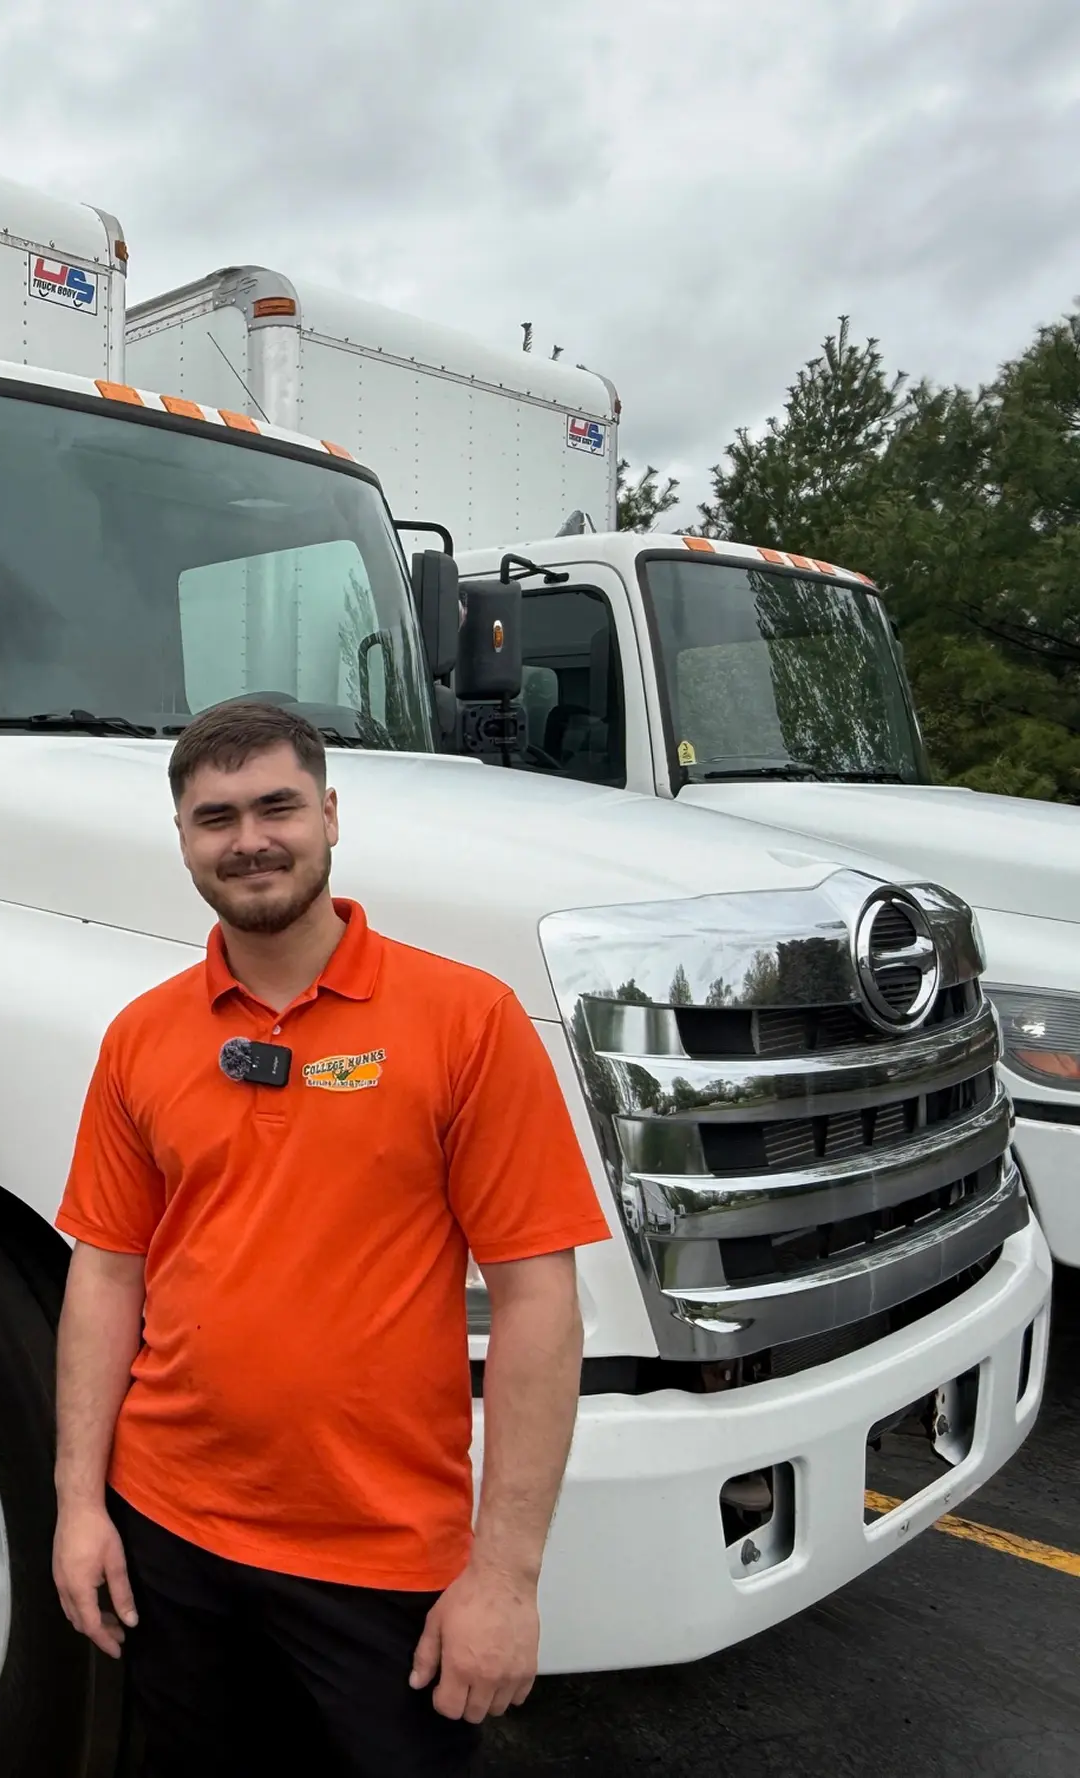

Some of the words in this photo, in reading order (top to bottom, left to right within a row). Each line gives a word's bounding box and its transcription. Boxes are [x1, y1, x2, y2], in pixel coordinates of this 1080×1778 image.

[33, 278, 57, 293] TRUCK
[57, 285, 77, 299] BODY
[34, 258, 95, 304] US
[570, 418, 603, 448] US
[303, 1059, 345, 1076] COLLEGE
[347, 1049, 385, 1068] HUNKS
